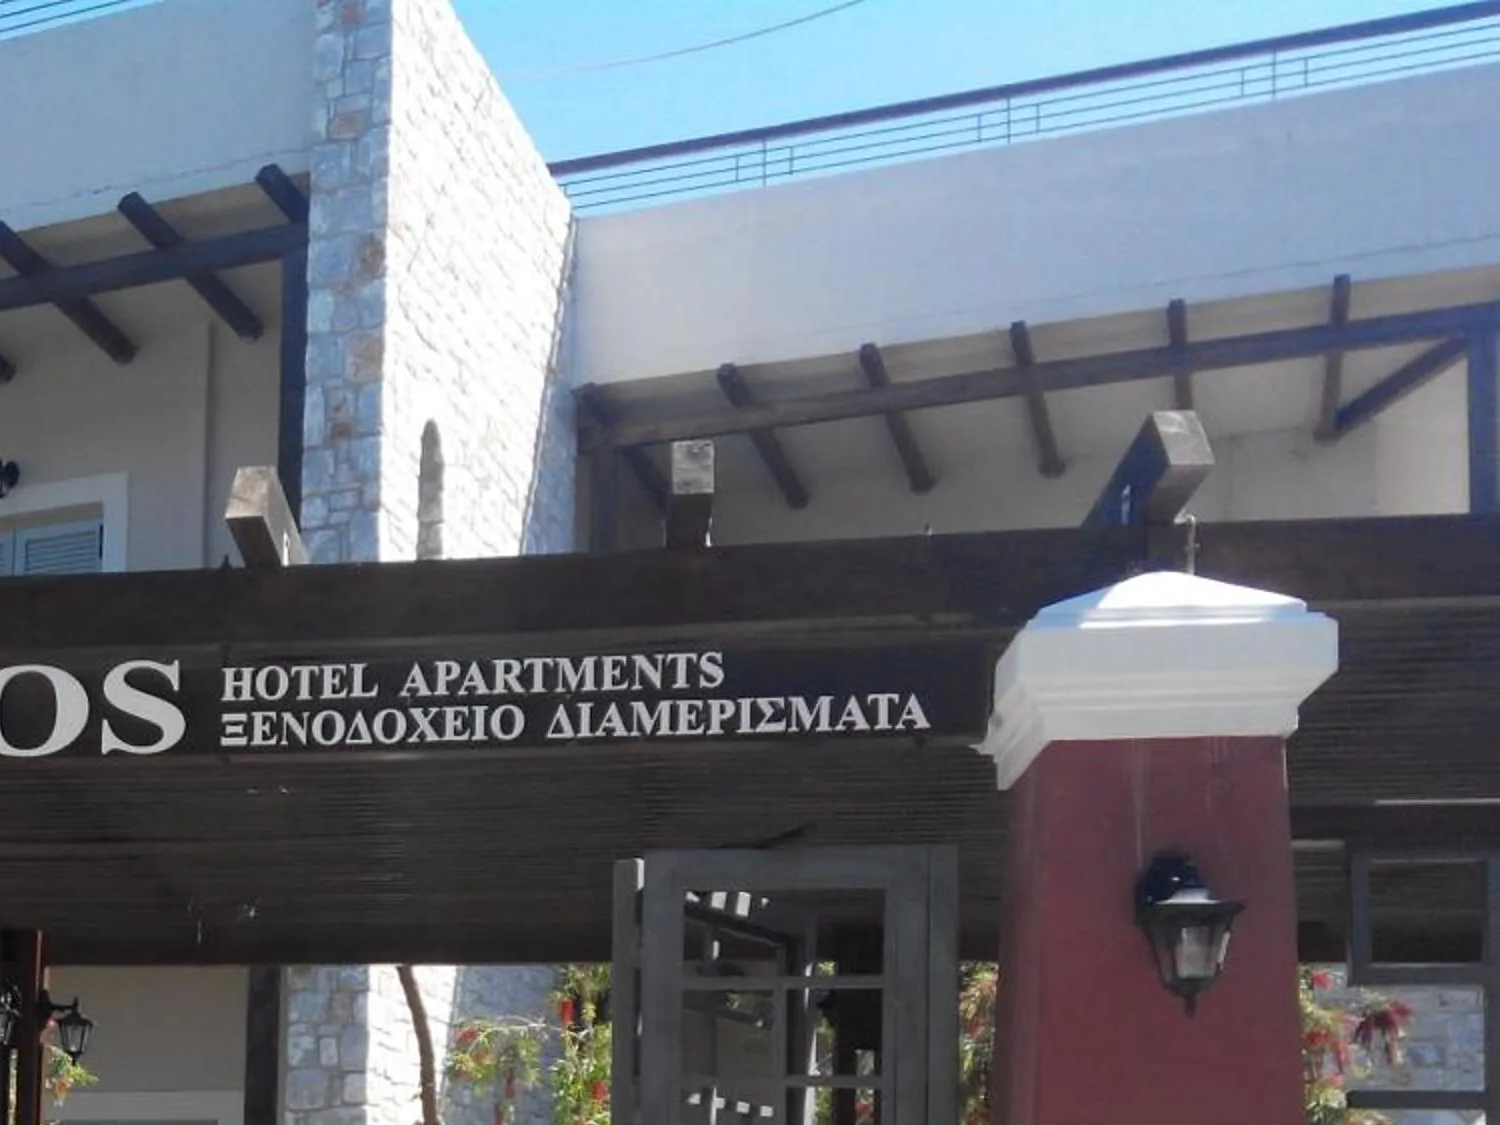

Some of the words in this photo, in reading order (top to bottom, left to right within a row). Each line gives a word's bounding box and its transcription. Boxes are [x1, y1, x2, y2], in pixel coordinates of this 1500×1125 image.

[220, 663, 379, 702] HOTEL
[400, 651, 725, 700] APARTMENTS
[220, 702, 526, 748] ΞΕΝΟΔΟΧΕΙΟ
[545, 691, 931, 740] ΔΙΑΜΕΡΙΣΜΑΤΑ
